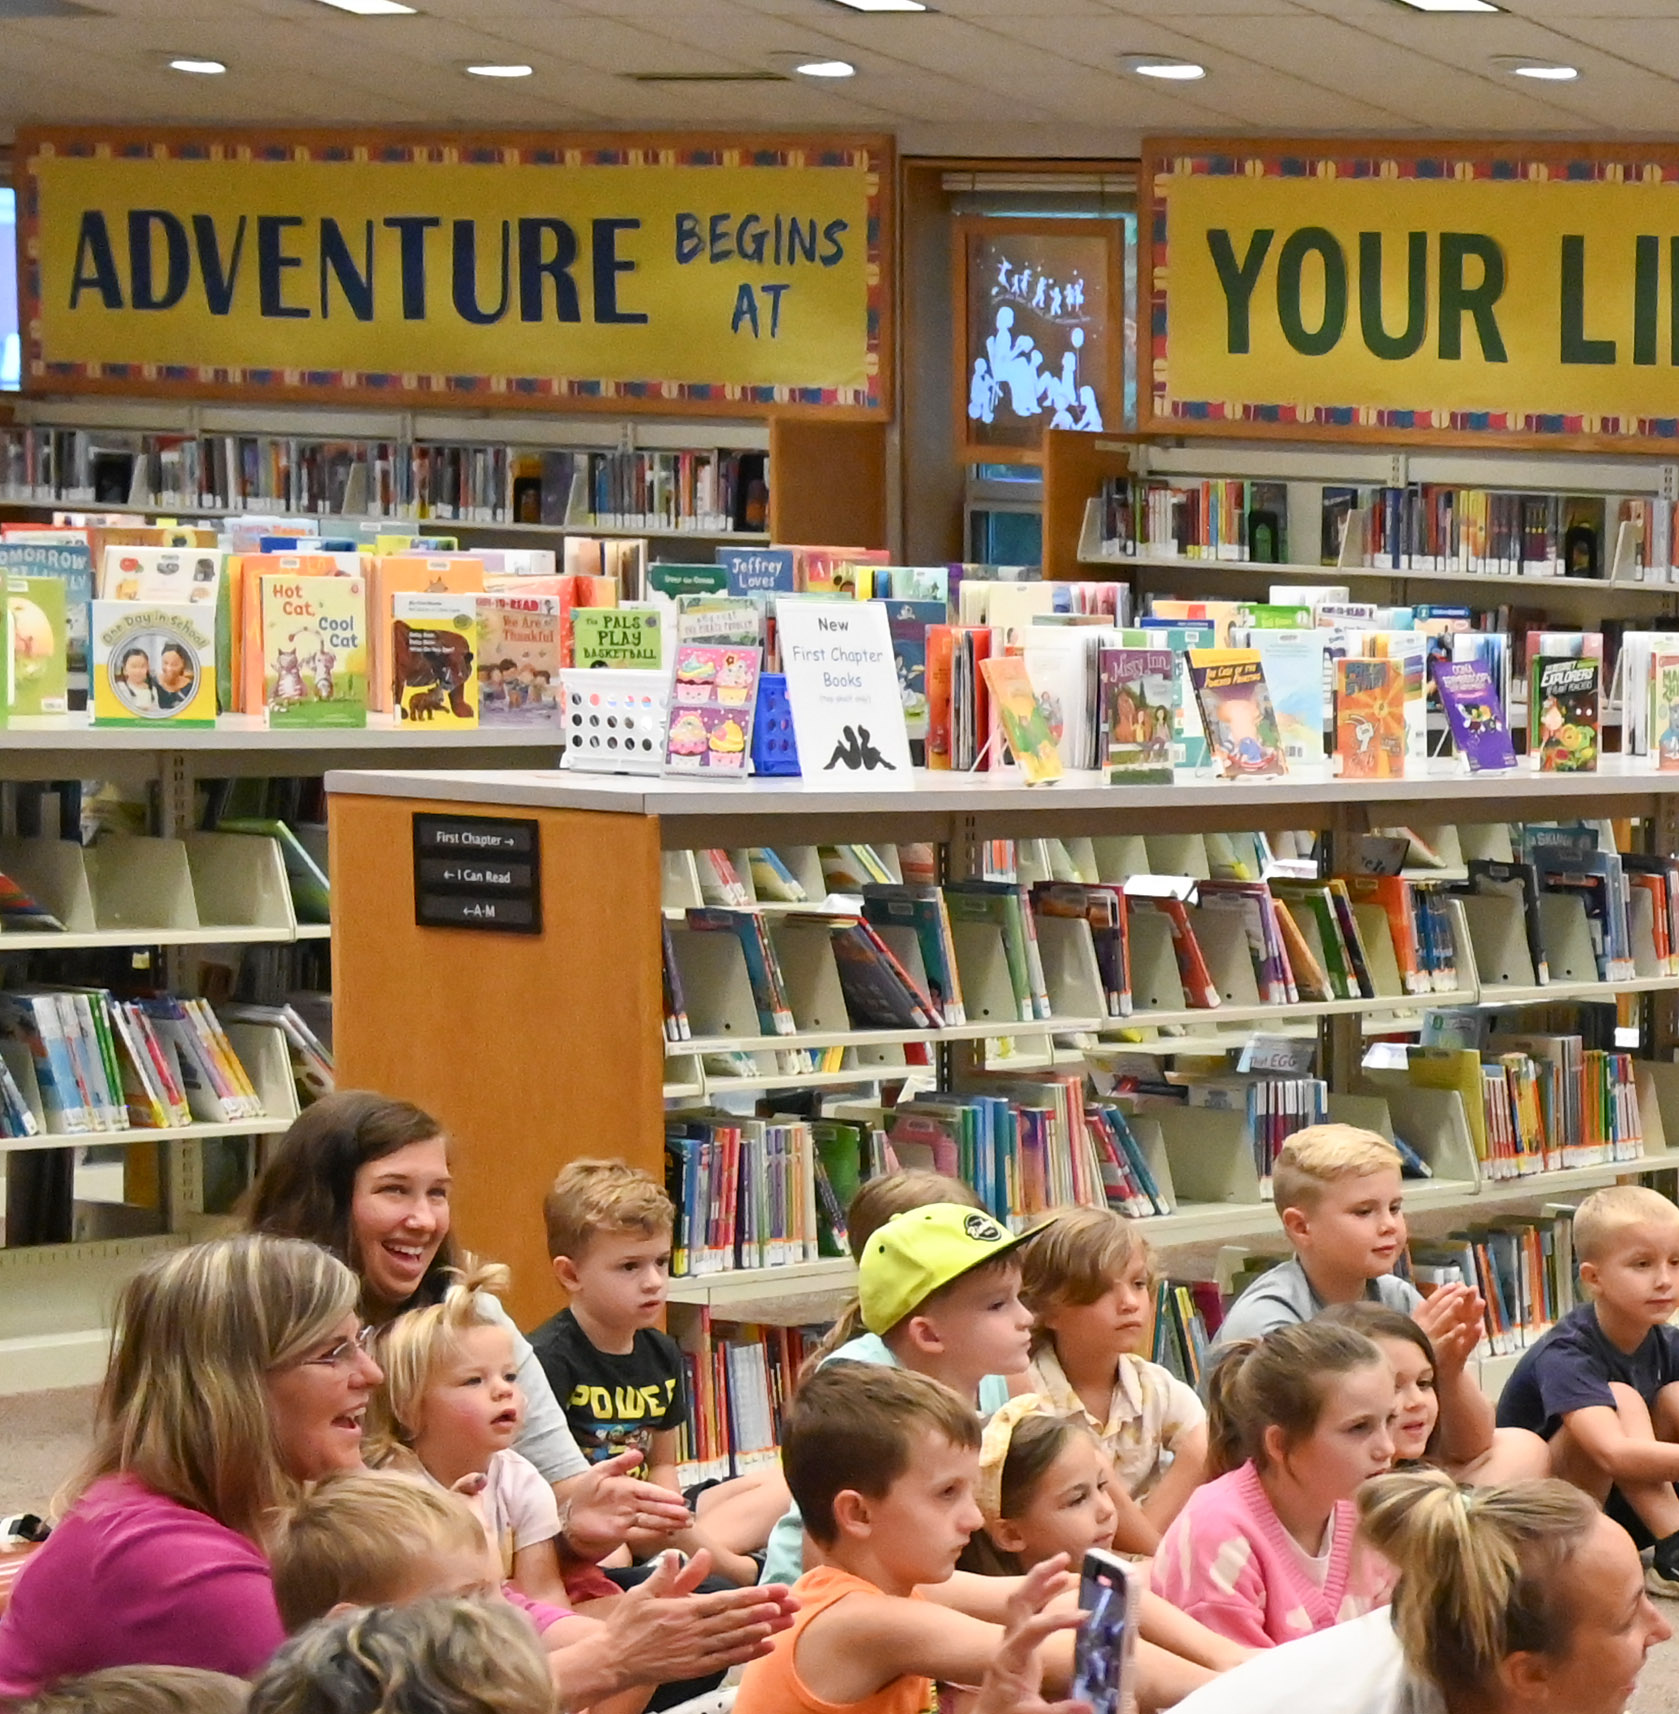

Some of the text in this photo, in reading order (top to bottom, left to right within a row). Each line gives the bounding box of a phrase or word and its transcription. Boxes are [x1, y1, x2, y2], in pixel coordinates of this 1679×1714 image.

[674, 211, 850, 267] BEGINS
[68, 209, 648, 326] ADVENTURE
[1206, 225, 1508, 364] YOUR
[730, 283, 791, 339] AT
[0, 550, 88, 569] OMORROW
[732, 557, 783, 576] Jeffrey
[739, 574, 775, 589] Loves
[273, 584, 303, 599] Hot
[103, 611, 208, 649] One Day in School
[318, 616, 354, 632] Cool
[603, 615, 642, 630] PALS
[818, 617, 849, 632] New
[329, 634, 359, 649] Cat
[504, 629, 555, 643] Thankful
[597, 630, 643, 647] PLAY
[582, 648, 658, 661] BASKETBALL
[792, 645, 884, 666] First Chapter
[1111, 654, 1171, 683] Misty Inn
[823, 671, 863, 688] Books
[1541, 667, 1594, 688] EXPLORERS
[436, 831, 502, 847] First Chapter
[458, 869, 511, 884] I Can Read
[473, 904, 496, 918] A-M
[1270, 1053, 1297, 1067] EGG
